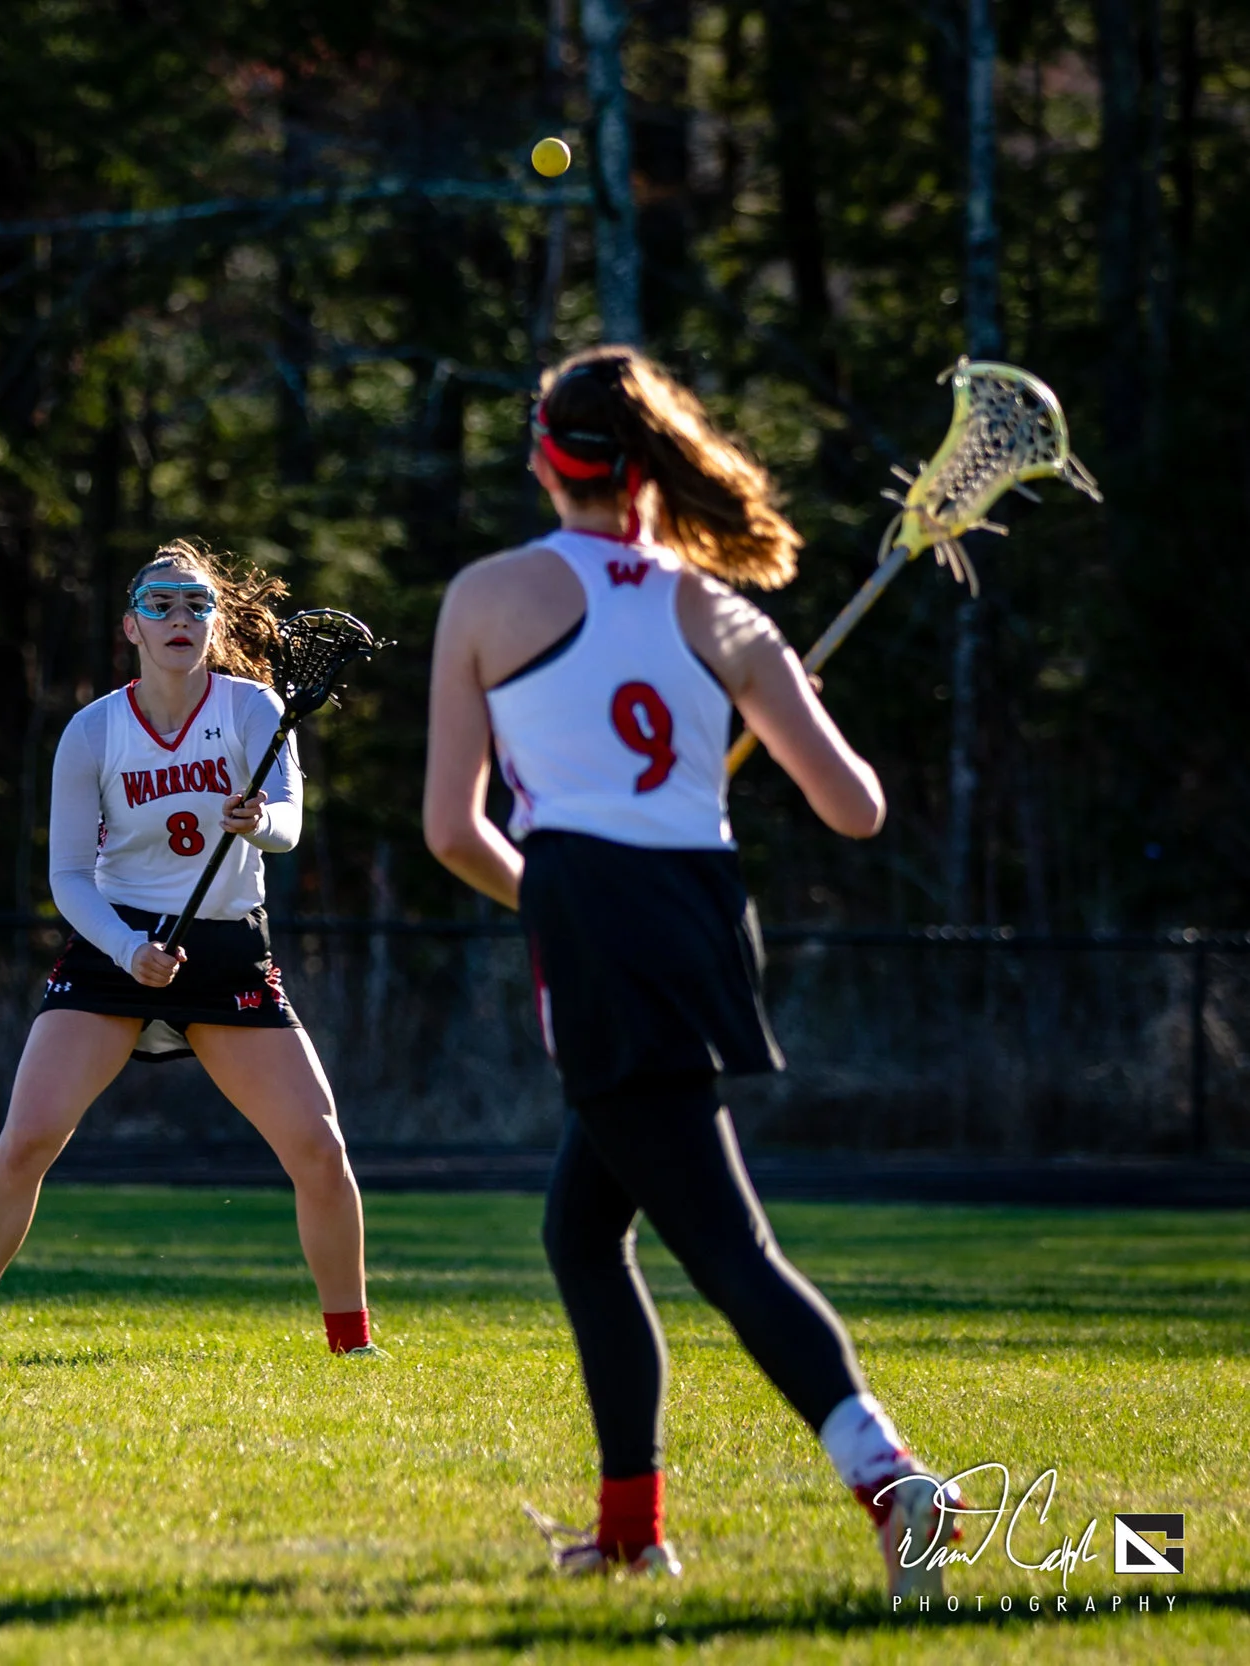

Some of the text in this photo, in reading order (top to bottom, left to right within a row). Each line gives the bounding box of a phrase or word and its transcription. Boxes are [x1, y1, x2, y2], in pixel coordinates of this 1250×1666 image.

[607, 560, 651, 587] W
[610, 681, 677, 794] 9
[121, 757, 233, 808] WARRIORS
[166, 811, 205, 856] 8
